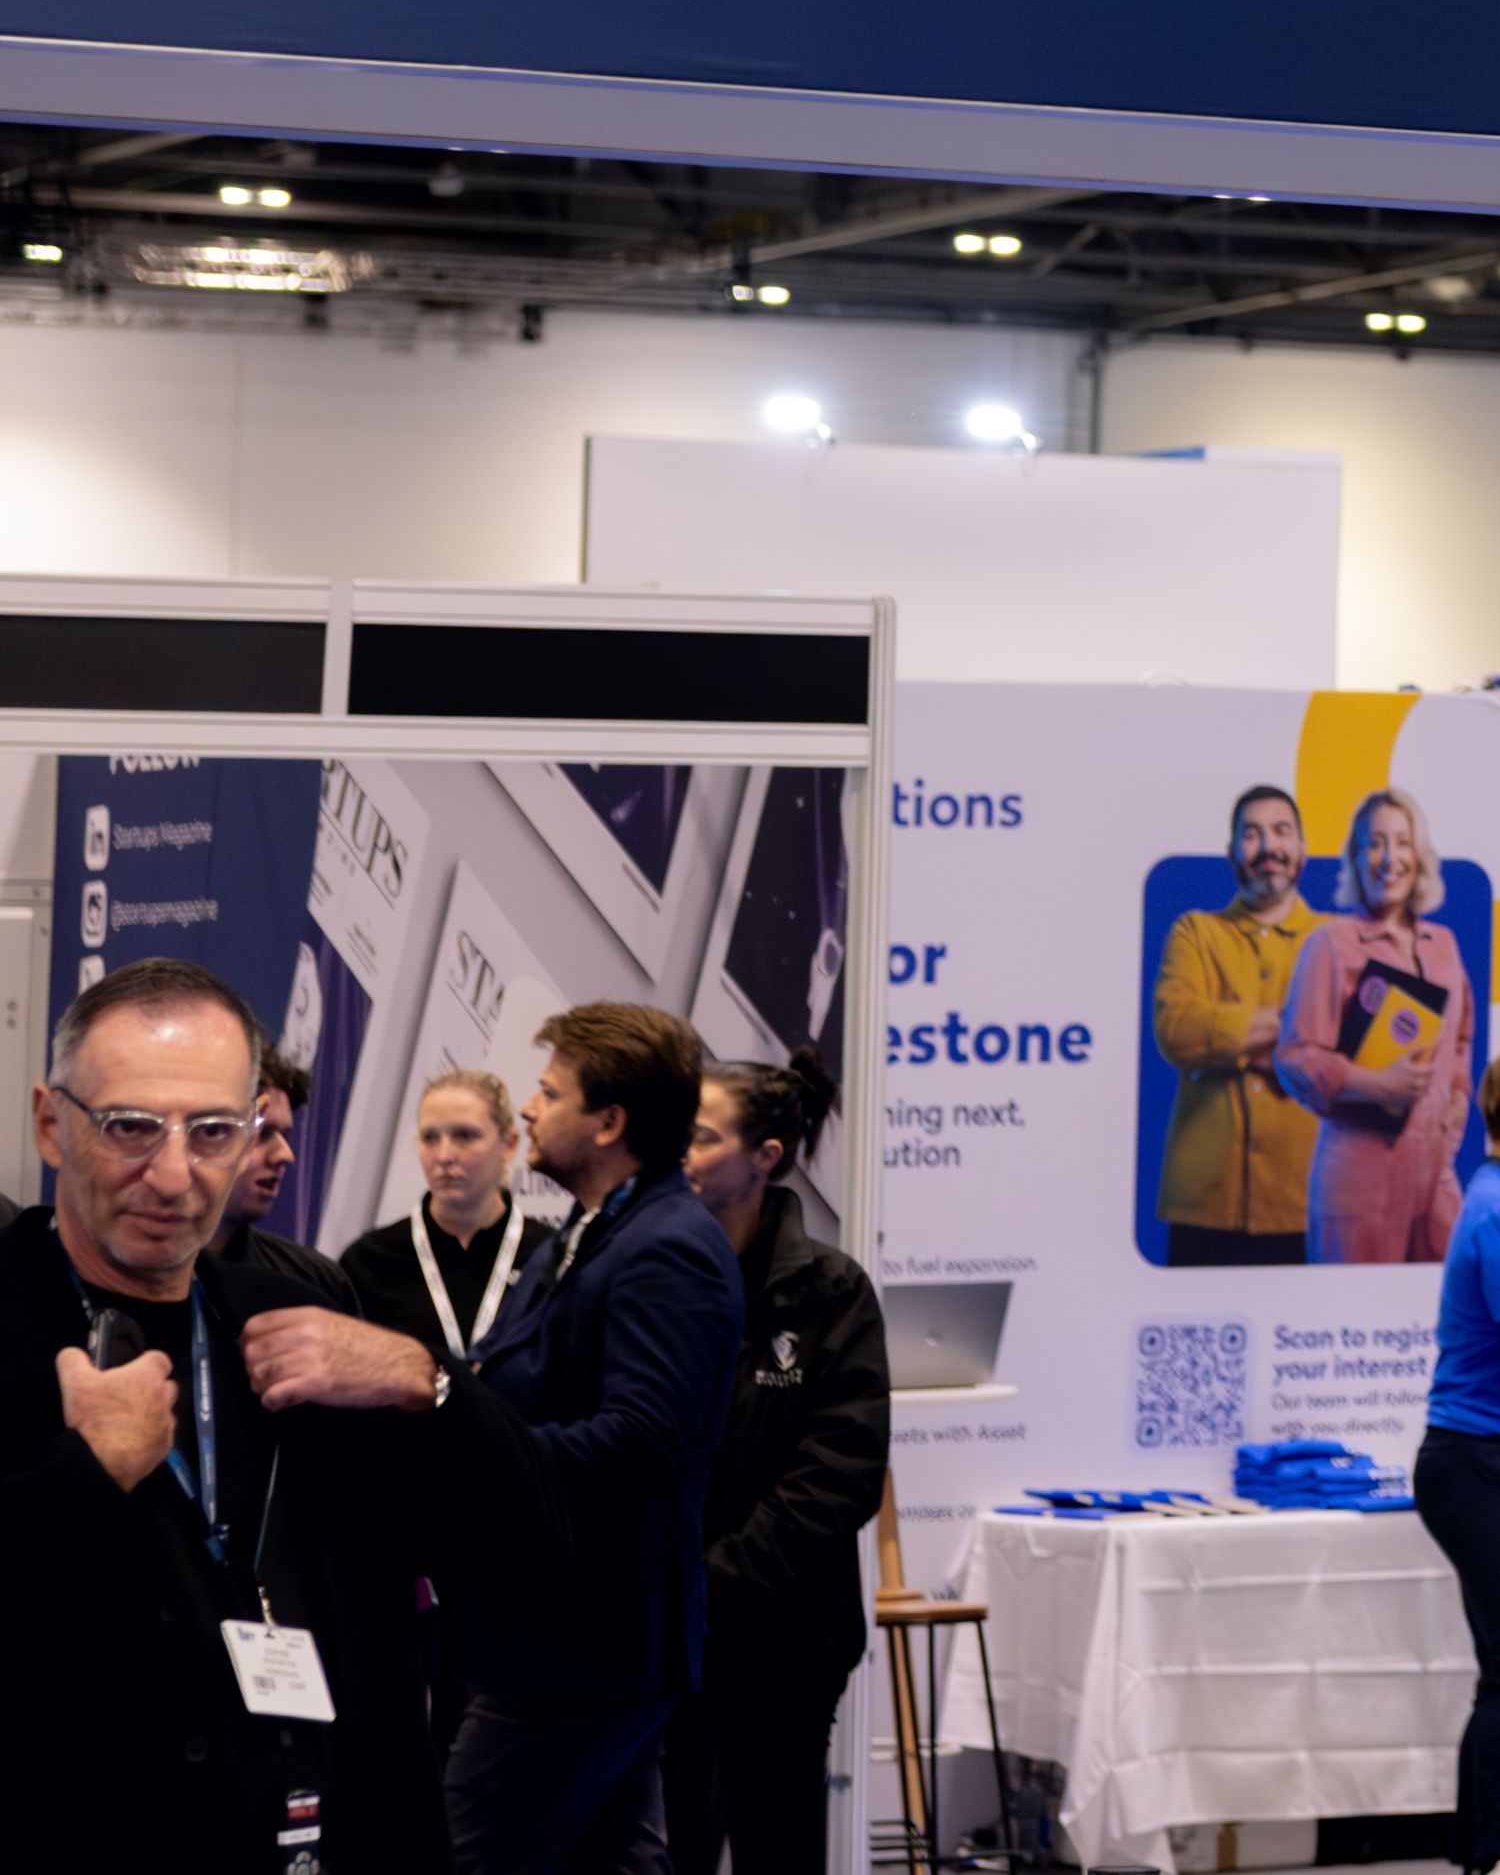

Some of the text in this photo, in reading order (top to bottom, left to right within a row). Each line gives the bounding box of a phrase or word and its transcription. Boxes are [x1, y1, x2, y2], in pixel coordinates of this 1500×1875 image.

[1274, 1322, 1434, 1353] Scan to regis
[1272, 1354, 1428, 1388] your interest
